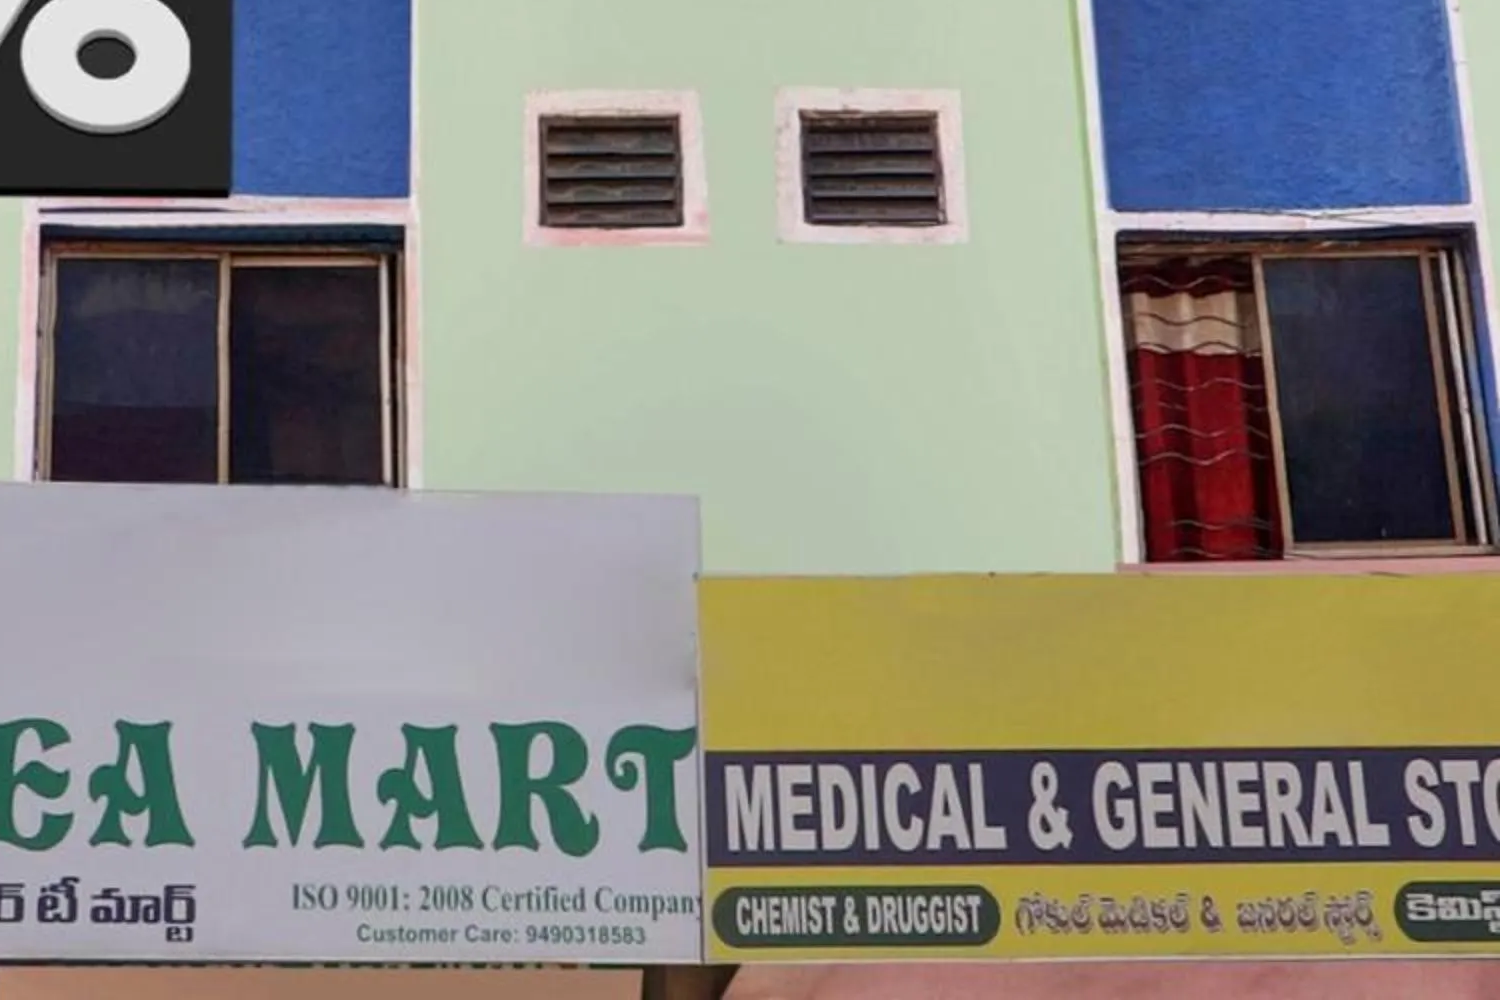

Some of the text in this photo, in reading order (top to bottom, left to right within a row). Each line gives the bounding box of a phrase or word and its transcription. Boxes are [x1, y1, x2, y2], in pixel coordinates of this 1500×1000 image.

[242, 720, 697, 857] MART
[724, 762, 1007, 851] MEDICAL
[1028, 761, 1073, 850] &
[1092, 760, 1390, 850] GENERAL
[37, 876, 80, 924] టీ
[90, 884, 197, 942] మార్ట్
[292, 883, 339, 912] ISO
[346, 884, 410, 912] 9001:
[418, 884, 474, 913] 2008
[482, 884, 587, 913] Certified
[736, 894, 981, 935] CHEMIST & DRUGGIST
[1200, 895, 1223, 932] &
[356, 923, 647, 945] Customer Care: 9490318583
